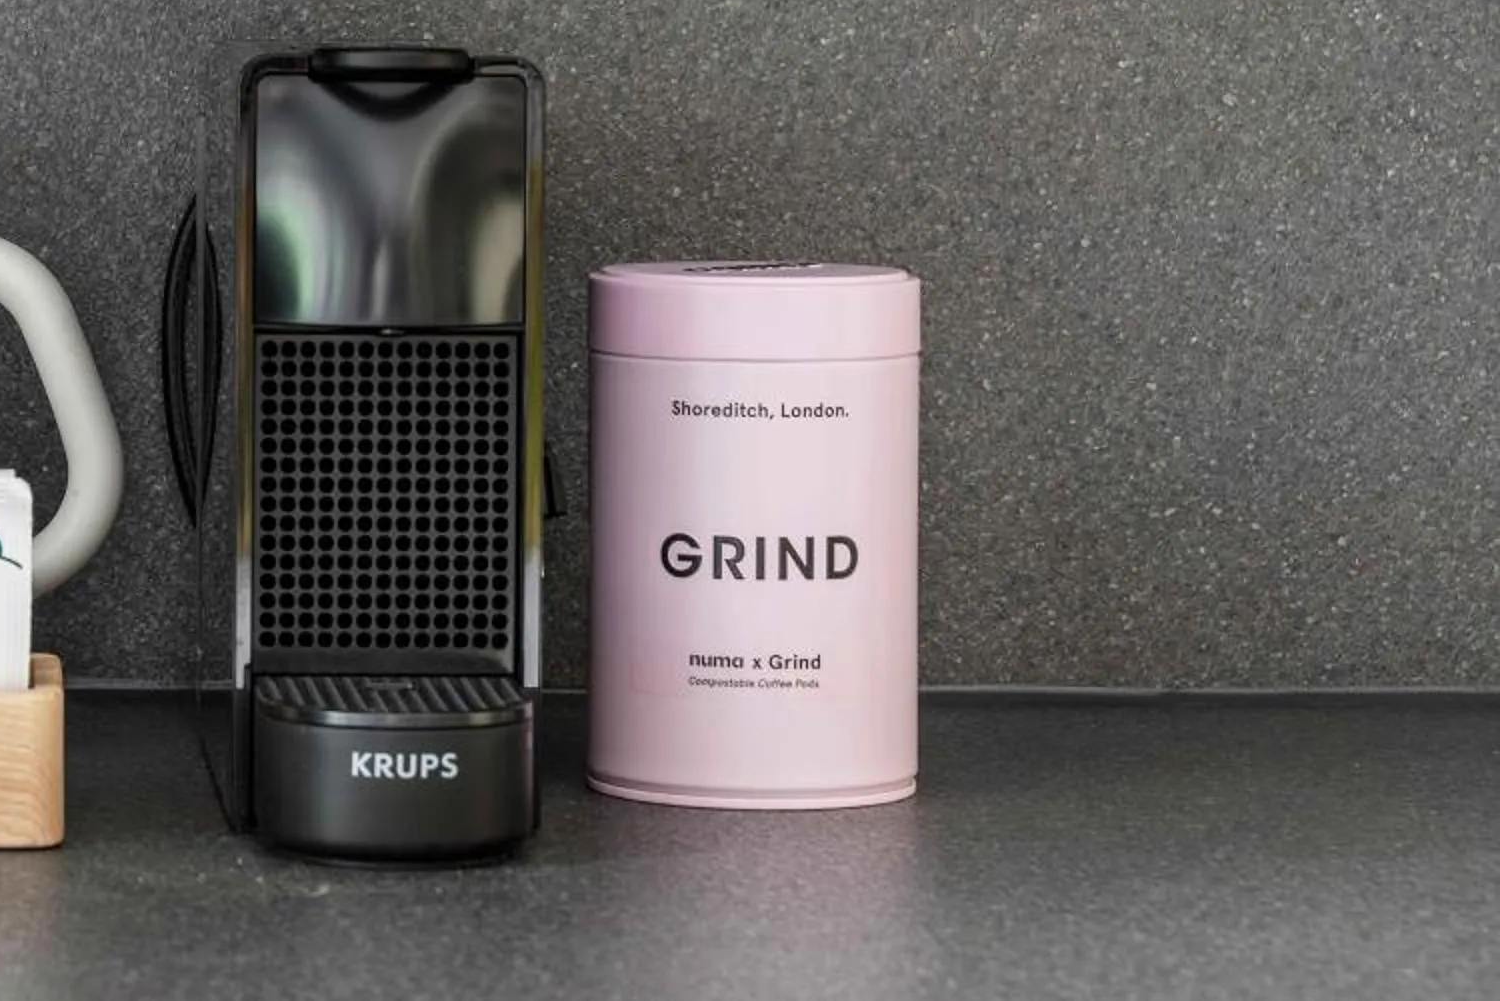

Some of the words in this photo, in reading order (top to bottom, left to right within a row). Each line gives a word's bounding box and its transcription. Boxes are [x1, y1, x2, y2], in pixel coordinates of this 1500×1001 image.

[672, 400, 775, 420] Shoreditch,
[781, 401, 849, 419] London.
[660, 532, 859, 581] GRIND
[689, 653, 744, 669] numa
[752, 657, 762, 669] x
[769, 654, 821, 670] Grind
[351, 751, 459, 779] KRUPS
